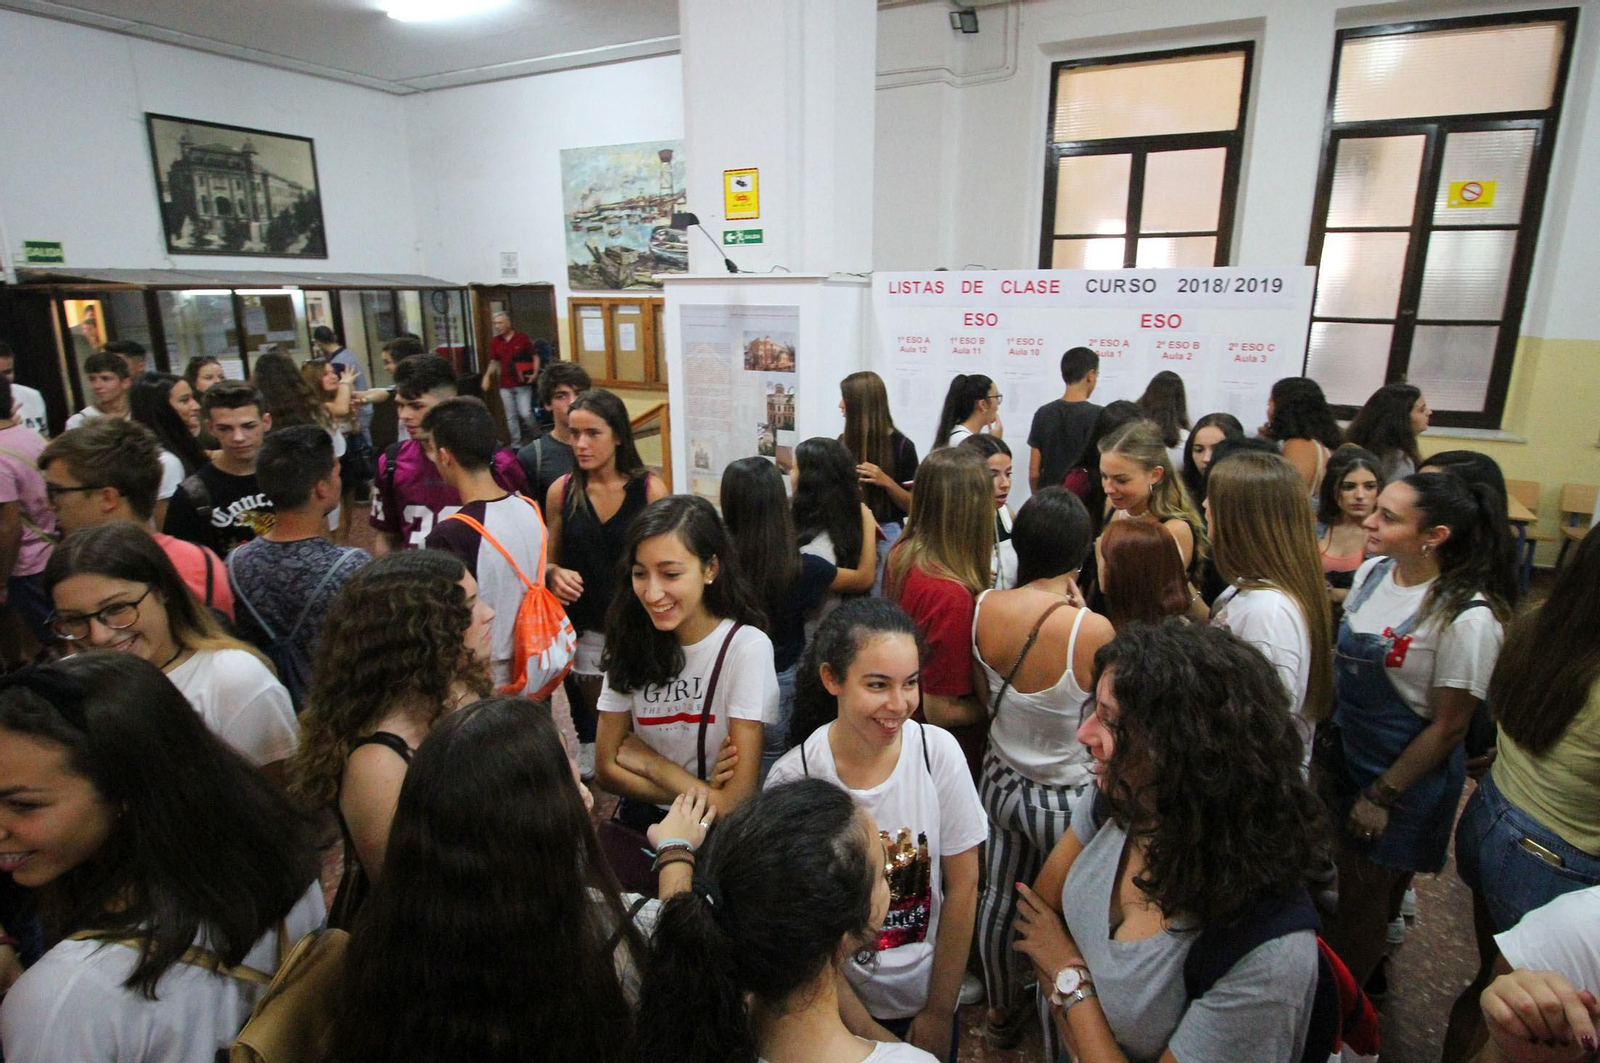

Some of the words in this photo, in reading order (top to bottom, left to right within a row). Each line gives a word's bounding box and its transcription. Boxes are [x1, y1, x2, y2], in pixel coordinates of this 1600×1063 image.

[888, 280, 945, 294] LISTAS
[961, 280, 984, 294] DE
[1000, 279, 1061, 294] CLASE
[1085, 278, 1157, 293] CURSO
[963, 312, 999, 327] ESO
[1140, 313, 1183, 329] ESO
[959, 337, 977, 345] ESO
[979, 337, 985, 345] B
[1016, 338, 1035, 346] ESO
[1037, 338, 1044, 346] C
[1100, 339, 1120, 347] ESO
[1122, 339, 1130, 347] A
[1168, 341, 1190, 349] ESO
[1192, 341, 1201, 349] B
[919, 346, 928, 354] 12
[1009, 348, 1028, 356] Aula
[1241, 343, 1265, 352] ESO
[1267, 343, 1276, 352] C
[1162, 351, 1184, 360] Aula
[1186, 352, 1193, 361] 2
[1233, 353, 1258, 363] Aula
[1260, 354, 1267, 363] 3
[643, 676, 703, 703] GIRL
